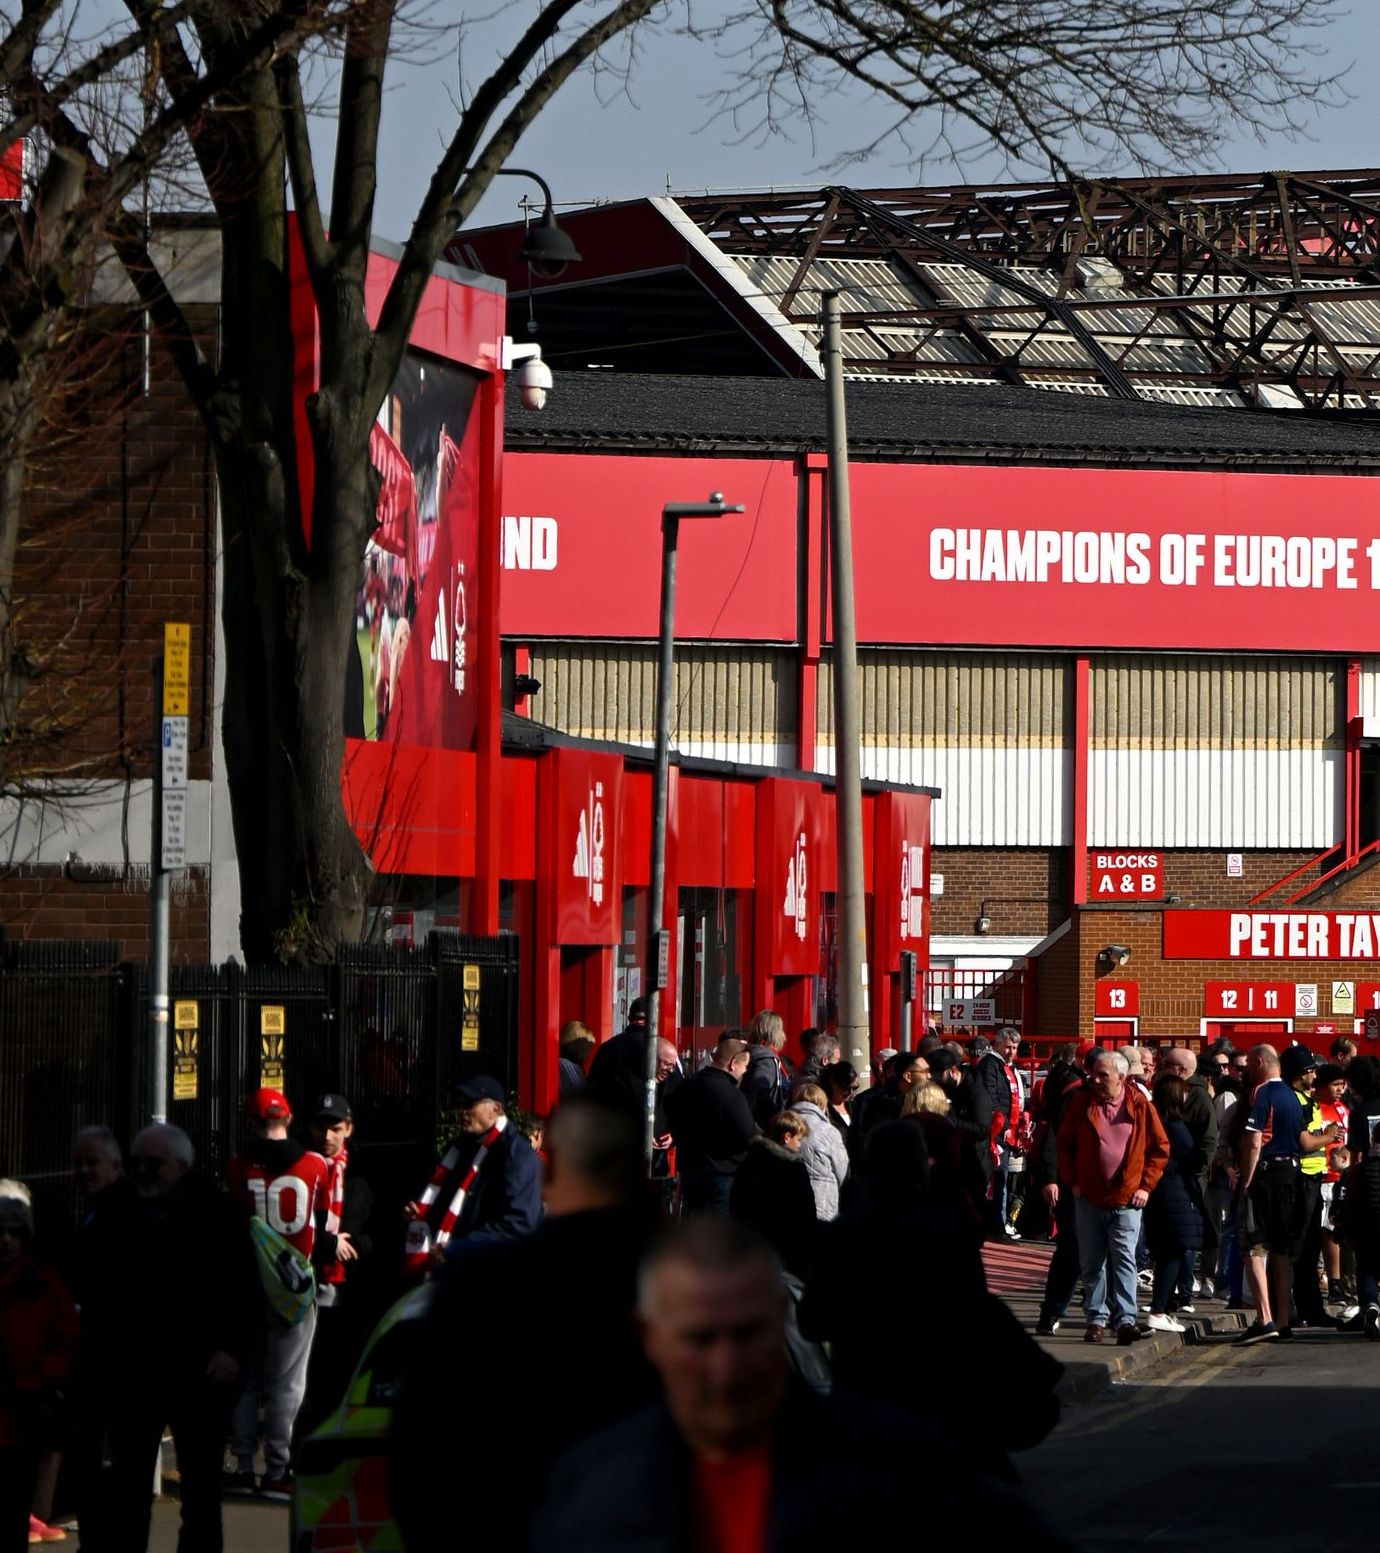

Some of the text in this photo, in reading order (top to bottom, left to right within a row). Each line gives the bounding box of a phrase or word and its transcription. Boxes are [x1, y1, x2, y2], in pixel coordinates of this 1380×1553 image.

[500, 516, 558, 571] ND
[929, 528, 1150, 585] CHAMPIONS
[1159, 534, 1206, 586] OF
[1214, 534, 1358, 590] EUROPE
[1096, 854, 1158, 869] BLOCKS
[1098, 874, 1156, 893] A & B
[1229, 913, 1329, 958] PETER
[1109, 989, 1126, 1008] 13
[1221, 989, 1278, 1009] 12 11
[949, 1003, 965, 1020] E2
[247, 1174, 309, 1236] 10
